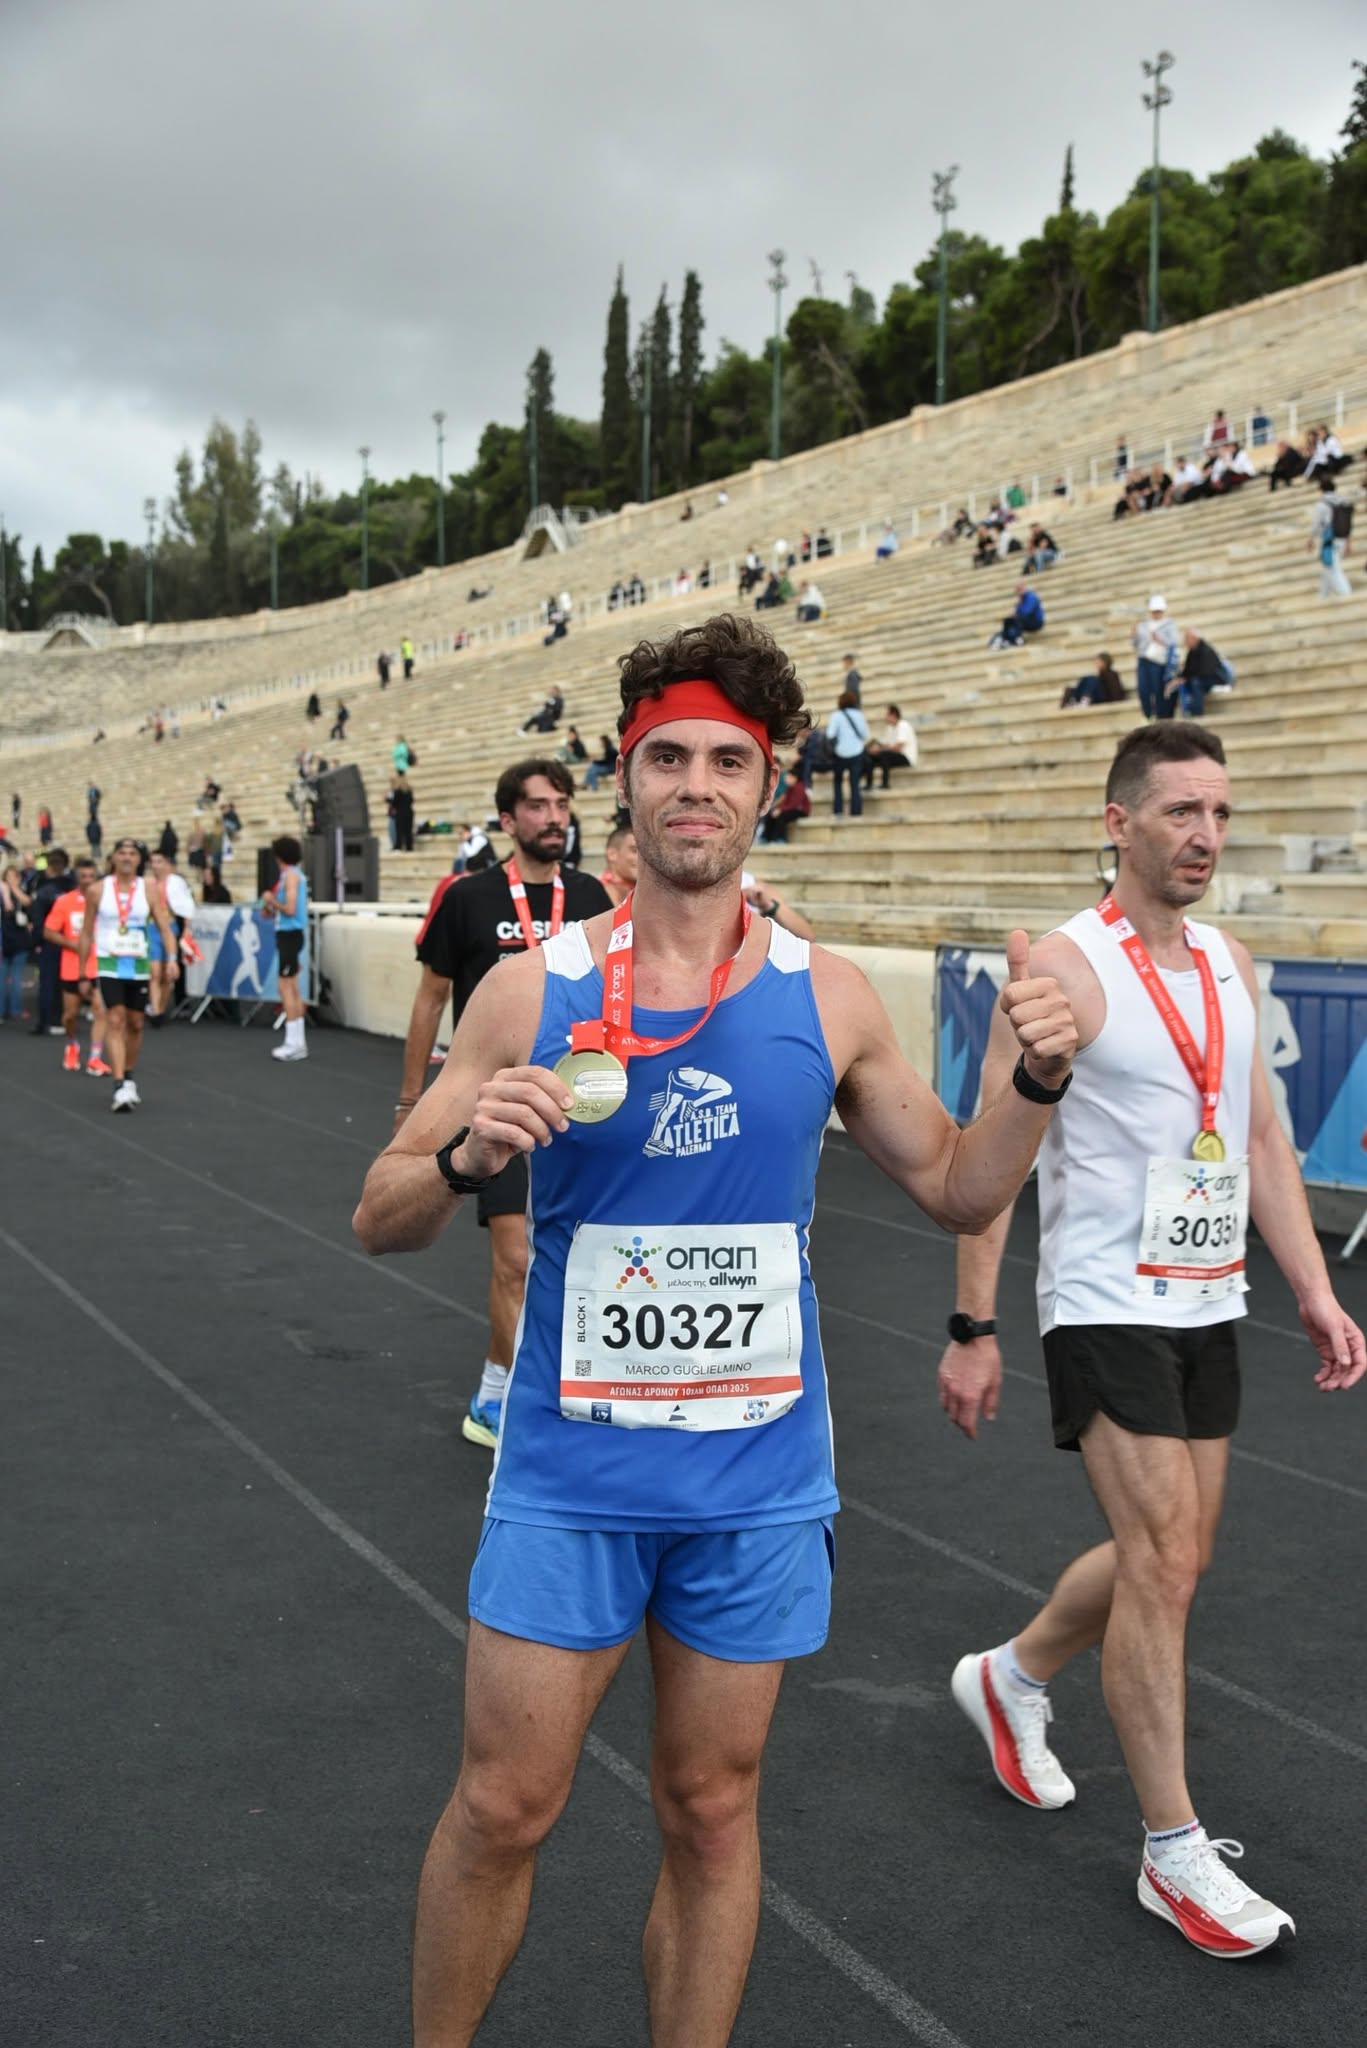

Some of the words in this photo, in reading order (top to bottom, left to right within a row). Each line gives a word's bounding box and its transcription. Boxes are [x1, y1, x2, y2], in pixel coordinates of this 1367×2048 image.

[715, 1102, 738, 1116] TEAM
[664, 1113, 741, 1149] ATLETICA
[675, 1141, 712, 1158] PALERMO
[709, 1272, 756, 1290] allwyn
[577, 1305, 586, 1343] BLOCK
[602, 1303, 764, 1350] 30327
[625, 1364, 670, 1376] MARCO
[673, 1361, 752, 1376] GUGLIELMINO
[729, 1383, 750, 1393] 2025
